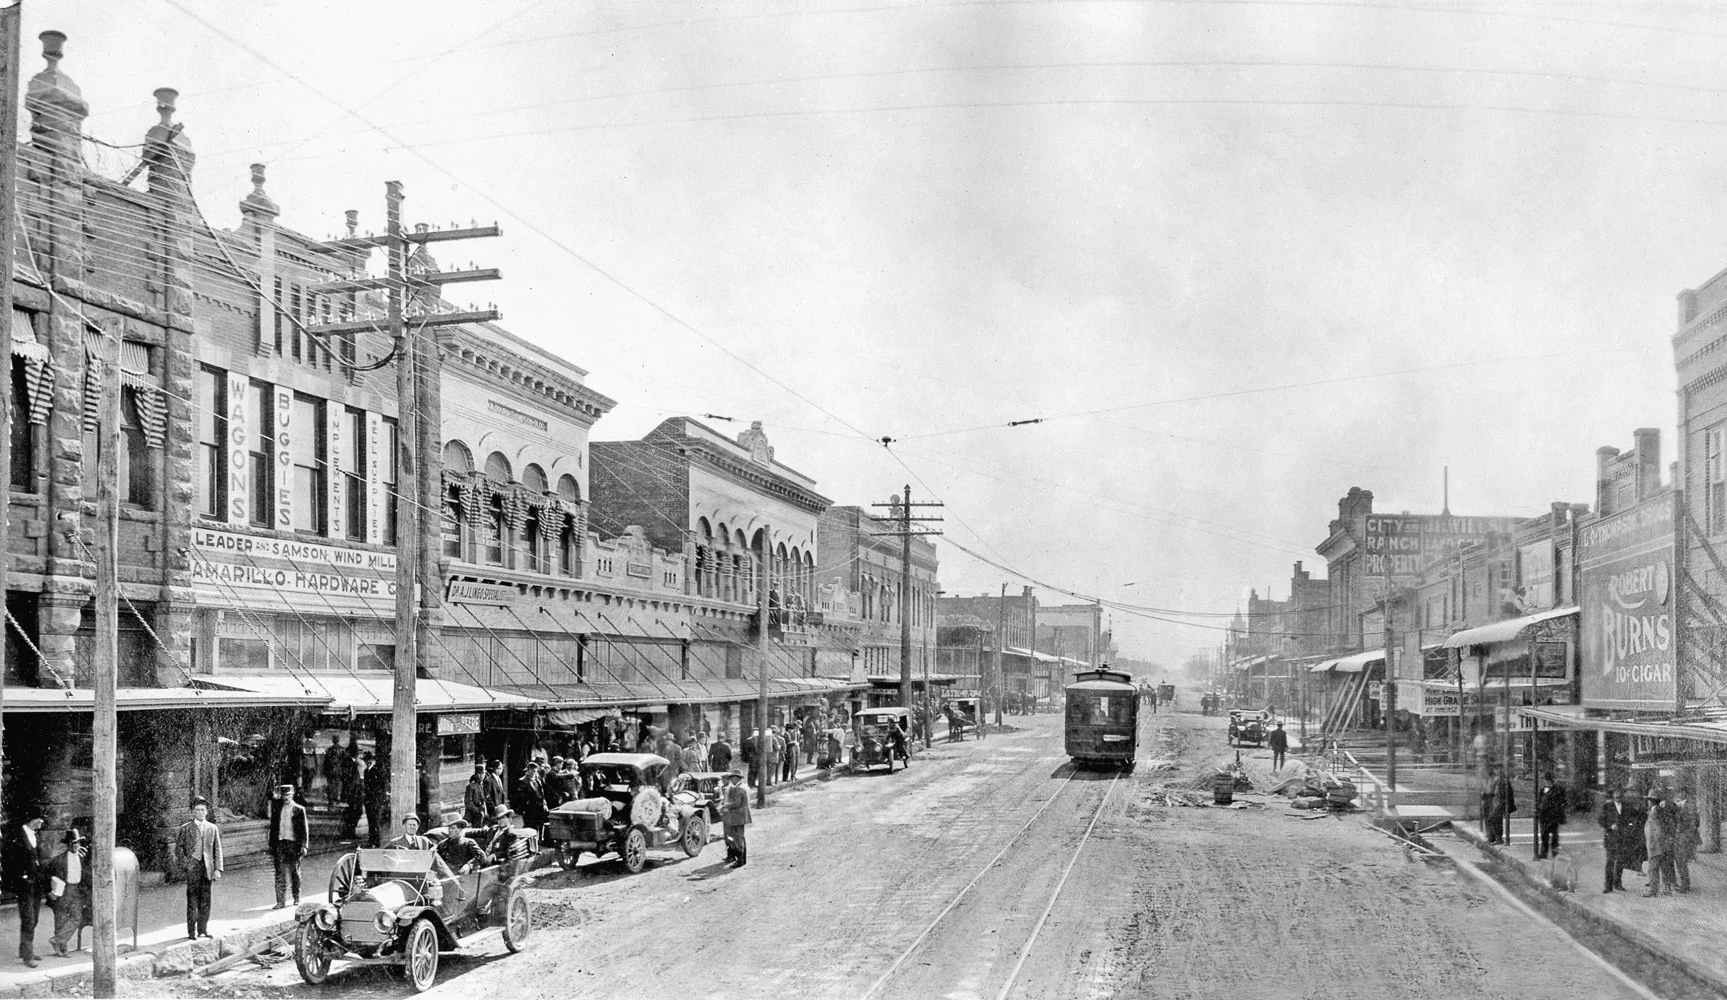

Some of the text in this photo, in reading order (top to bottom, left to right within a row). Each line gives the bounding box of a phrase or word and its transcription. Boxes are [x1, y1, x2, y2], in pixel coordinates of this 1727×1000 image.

[231, 379, 246, 519] WAGONS
[279, 393, 291, 526] BUGGIES
[1367, 519, 1403, 532] CITY
[196, 532, 253, 551] LEADER
[272, 543, 328, 561] SAMSON
[334, 550, 363, 564] WIND
[1367, 536, 1419, 550] RANCH
[295, 573, 379, 594] HARDWARE
[1608, 565, 1655, 608] ROBERT
[1603, 602, 1670, 676] BURNS
[1632, 663, 1671, 683] CIGAR
[1443, 696, 1469, 705] GRAE
